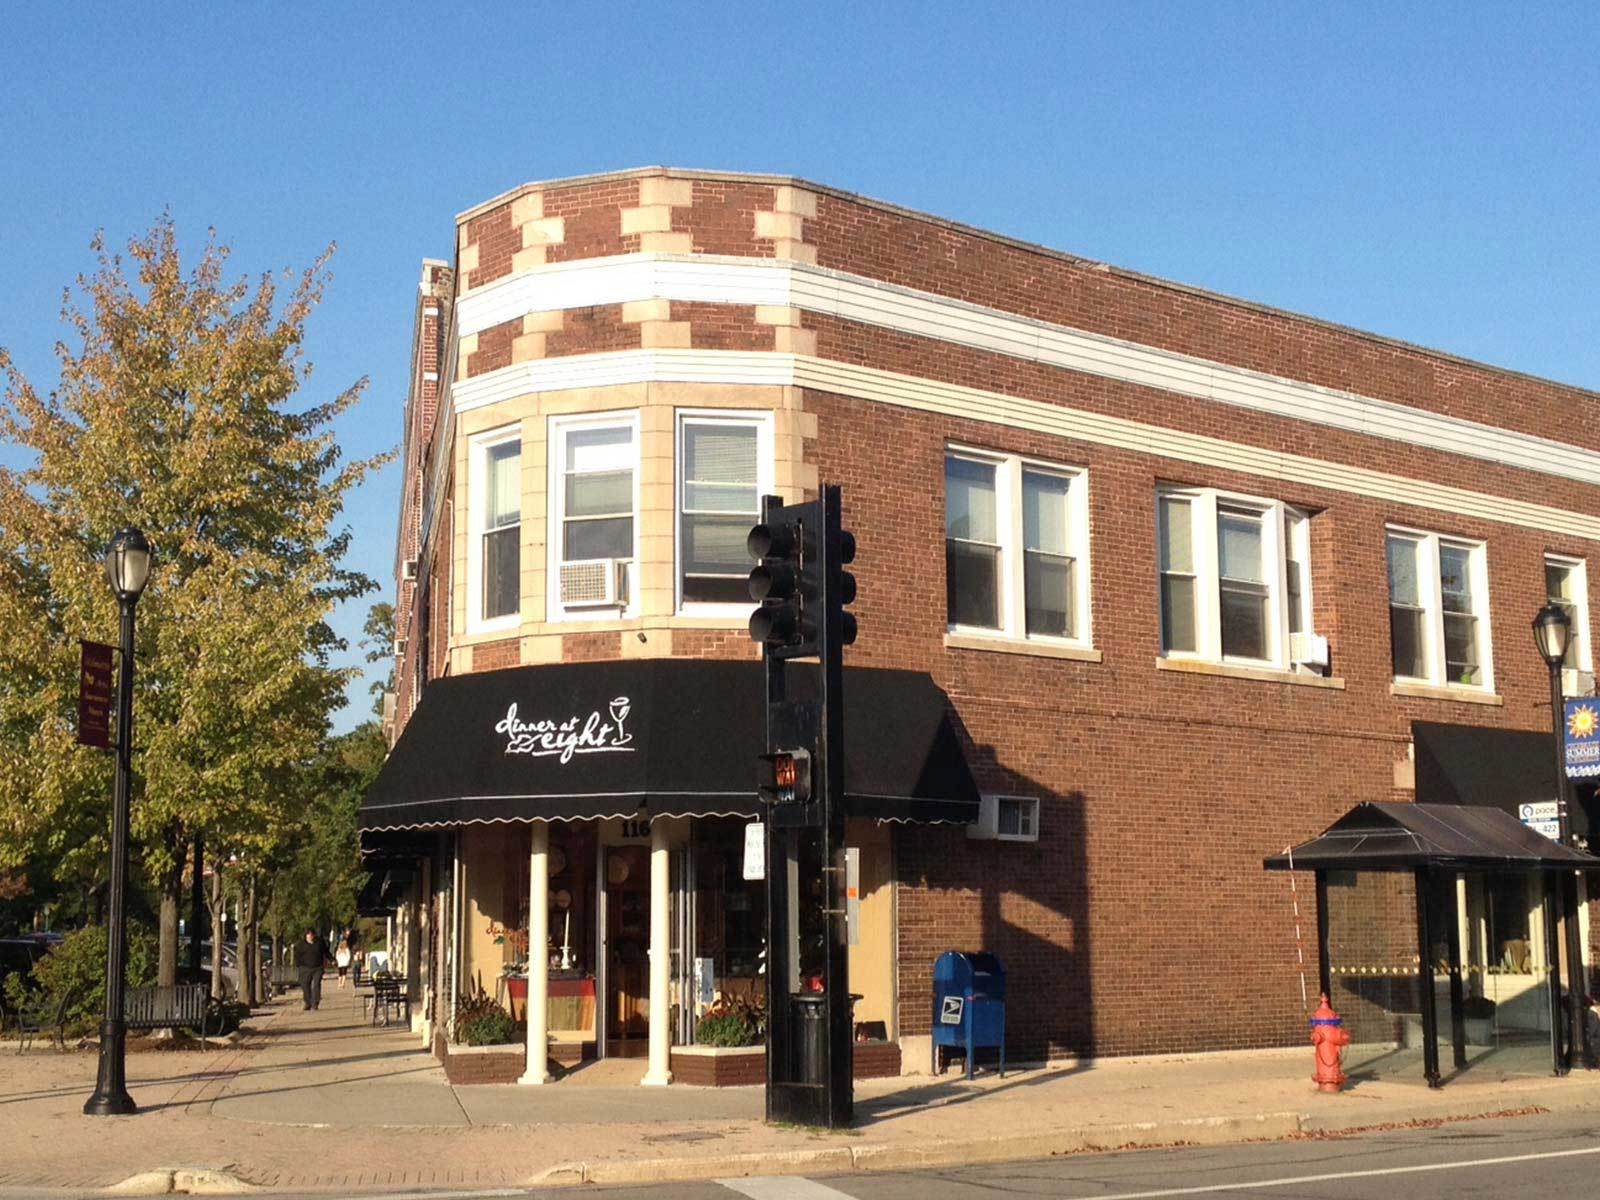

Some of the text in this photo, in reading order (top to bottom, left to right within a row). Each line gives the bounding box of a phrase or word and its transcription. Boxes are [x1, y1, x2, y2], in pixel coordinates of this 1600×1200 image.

[495, 702, 580, 739] dinner at
[541, 711, 613, 764] eight
[1535, 807, 1555, 815] pace
[622, 820, 651, 838] 116
[1543, 824, 1557, 833] 422
